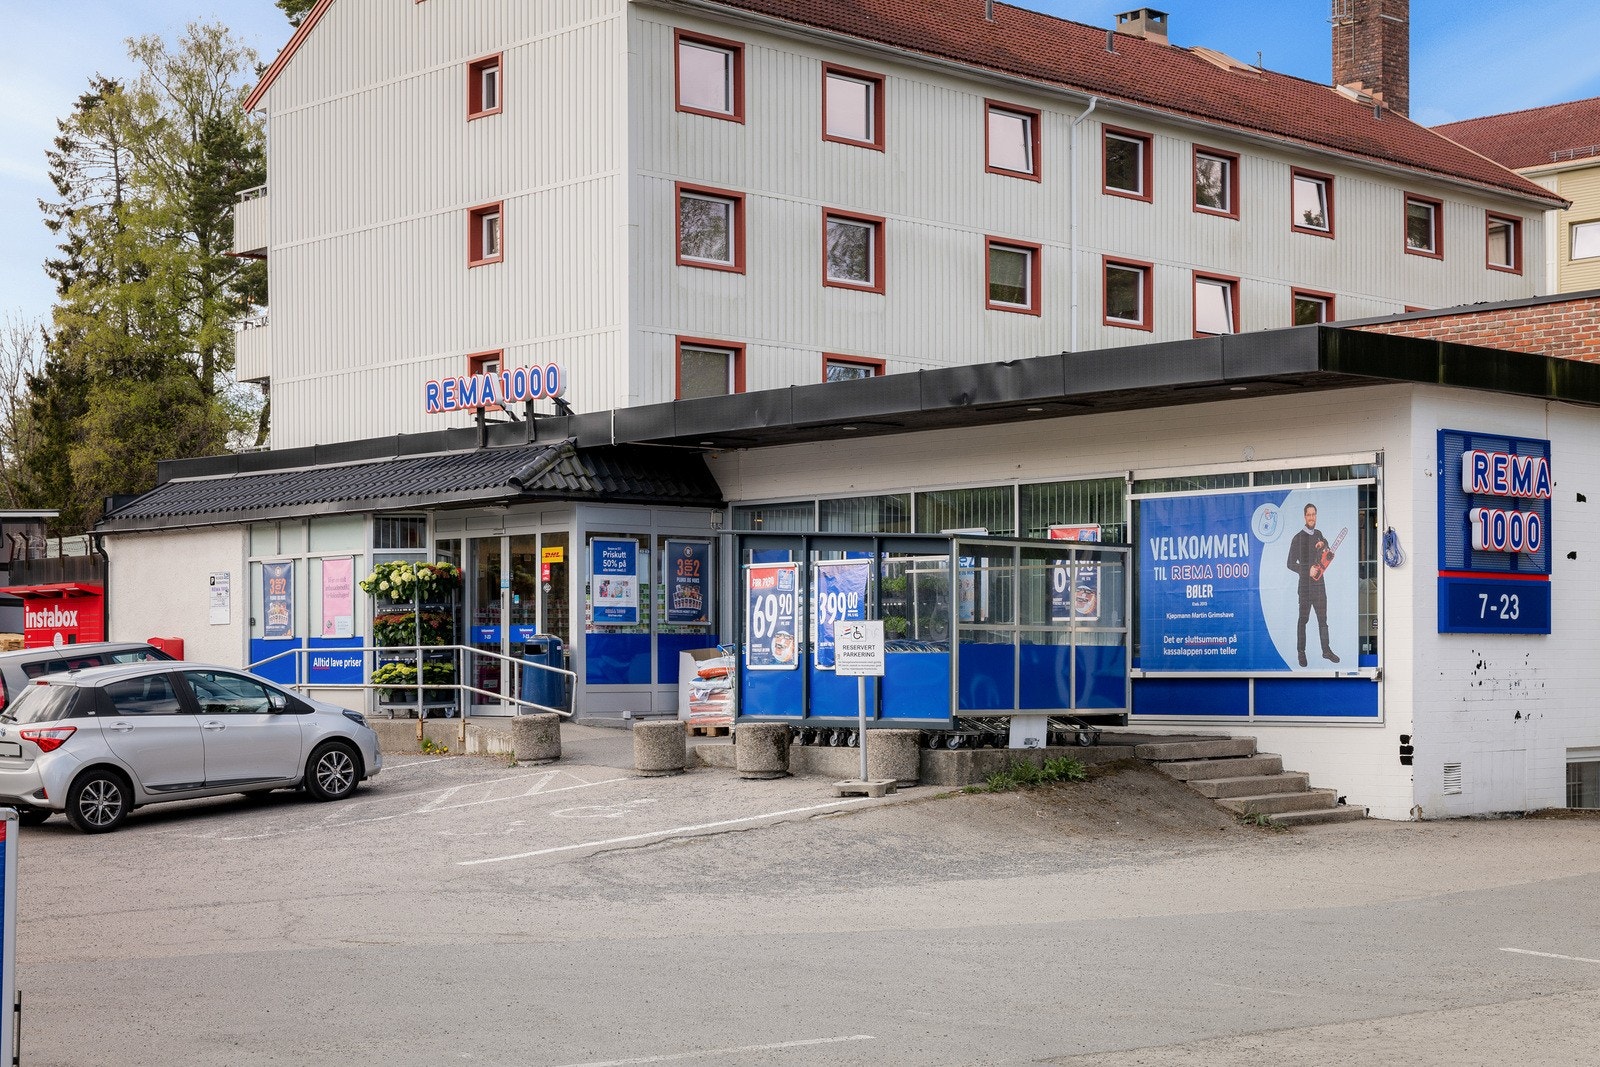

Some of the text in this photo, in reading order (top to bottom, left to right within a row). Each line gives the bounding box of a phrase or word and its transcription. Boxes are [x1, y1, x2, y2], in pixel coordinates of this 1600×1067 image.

[425, 362, 561, 414] REMA 1000
[1472, 449, 1552, 499] REMA
[1478, 507, 1543, 553] 1000
[544, 551, 561, 559] DHL
[602, 550, 626, 559] Priskutt
[1149, 532, 1250, 561] VELKOMMEN
[602, 559, 627, 569] 50% på
[677, 558, 700, 577] 3 FOR 2
[1153, 563, 1250, 581] TIL REMA 1000
[269, 578, 275, 595] 3
[281, 577, 286, 595] 2
[1186, 584, 1213, 599] BØLER
[25, 604, 78, 629] instabox
[753, 593, 793, 639] 69 90
[819, 591, 858, 625] 399 00
[1166, 612, 1191, 620] Kjøpmann
[1163, 635, 1175, 644] Det
[1184, 635, 1227, 645] sluttsummen
[1228, 634, 1237, 644] på
[1163, 647, 1203, 657] kassalappen
[1220, 647, 1237, 655] teller
[312, 657, 362, 669] Alltid lave priser
